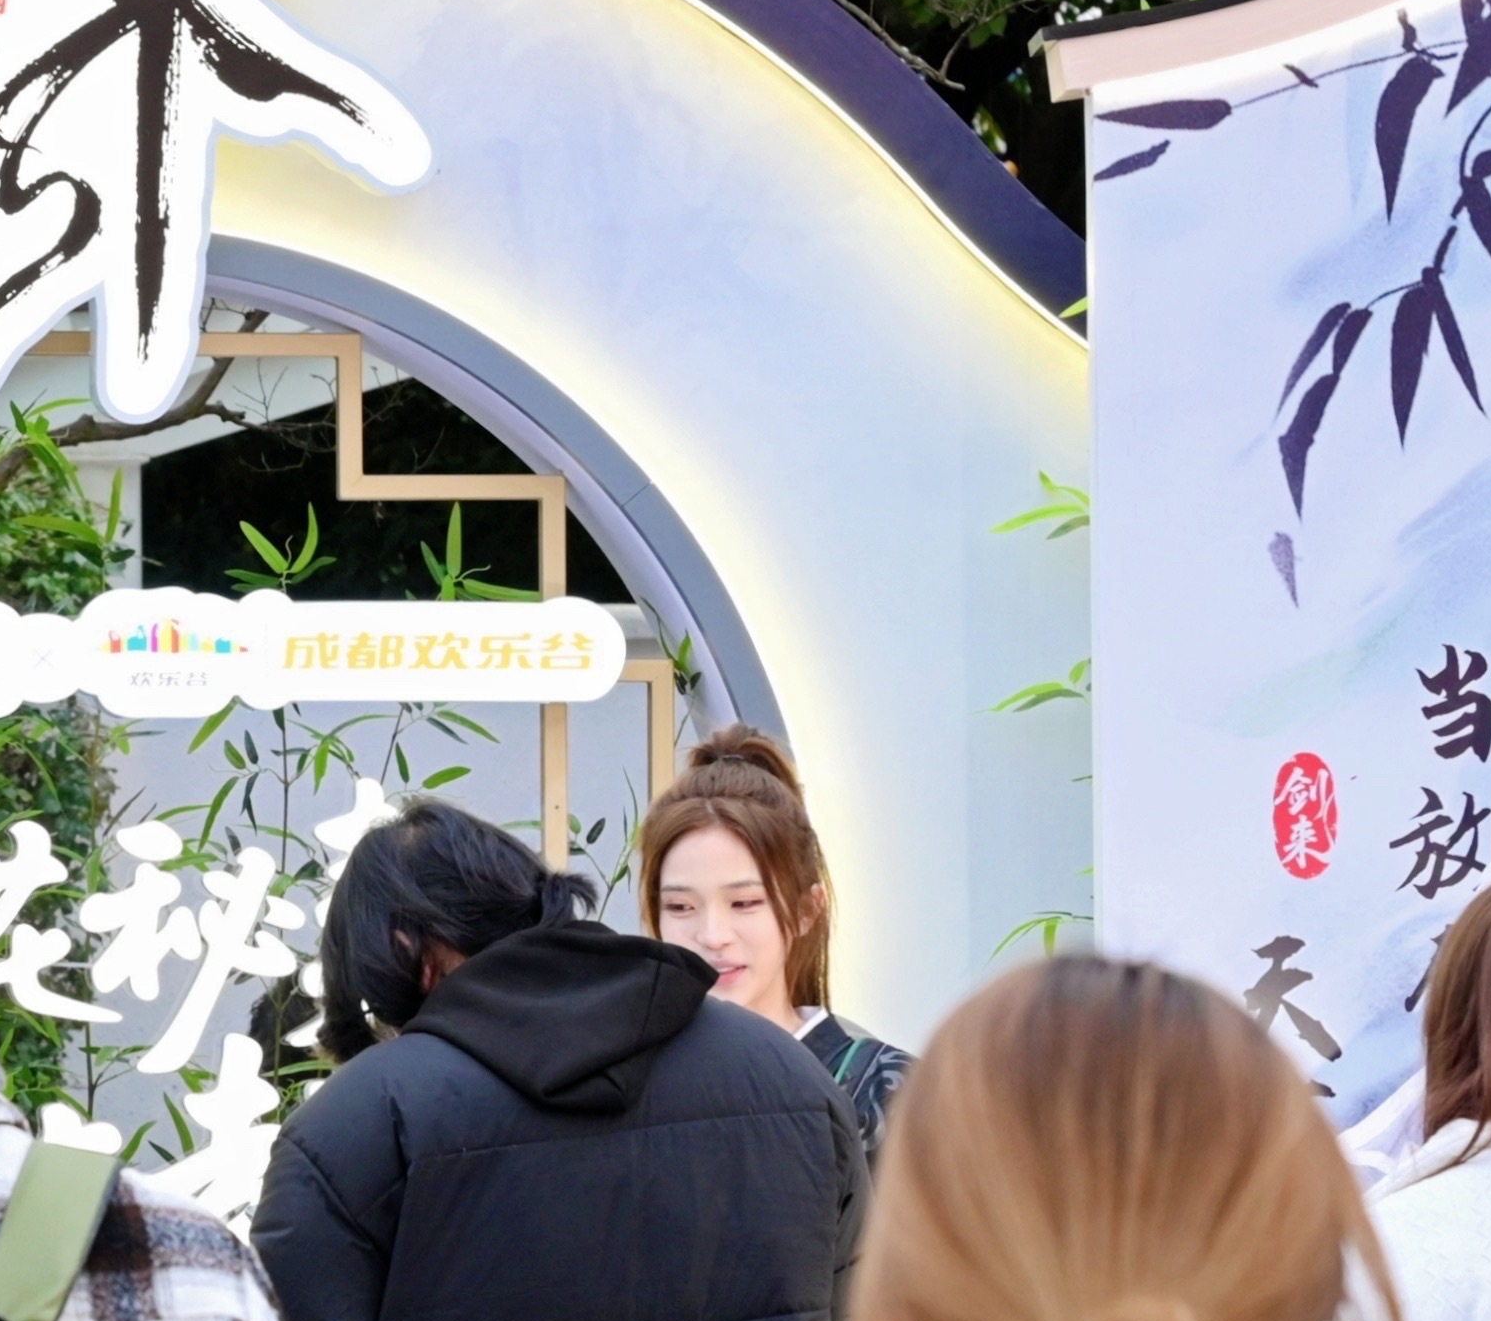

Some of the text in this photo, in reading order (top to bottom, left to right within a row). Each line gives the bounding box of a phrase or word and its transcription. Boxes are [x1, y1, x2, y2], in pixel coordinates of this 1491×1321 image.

[282, 631, 595, 670] 成都欢乐谷
[130, 671, 207, 687] 欢乐谷
[1274, 767, 1337, 872] 剑来
